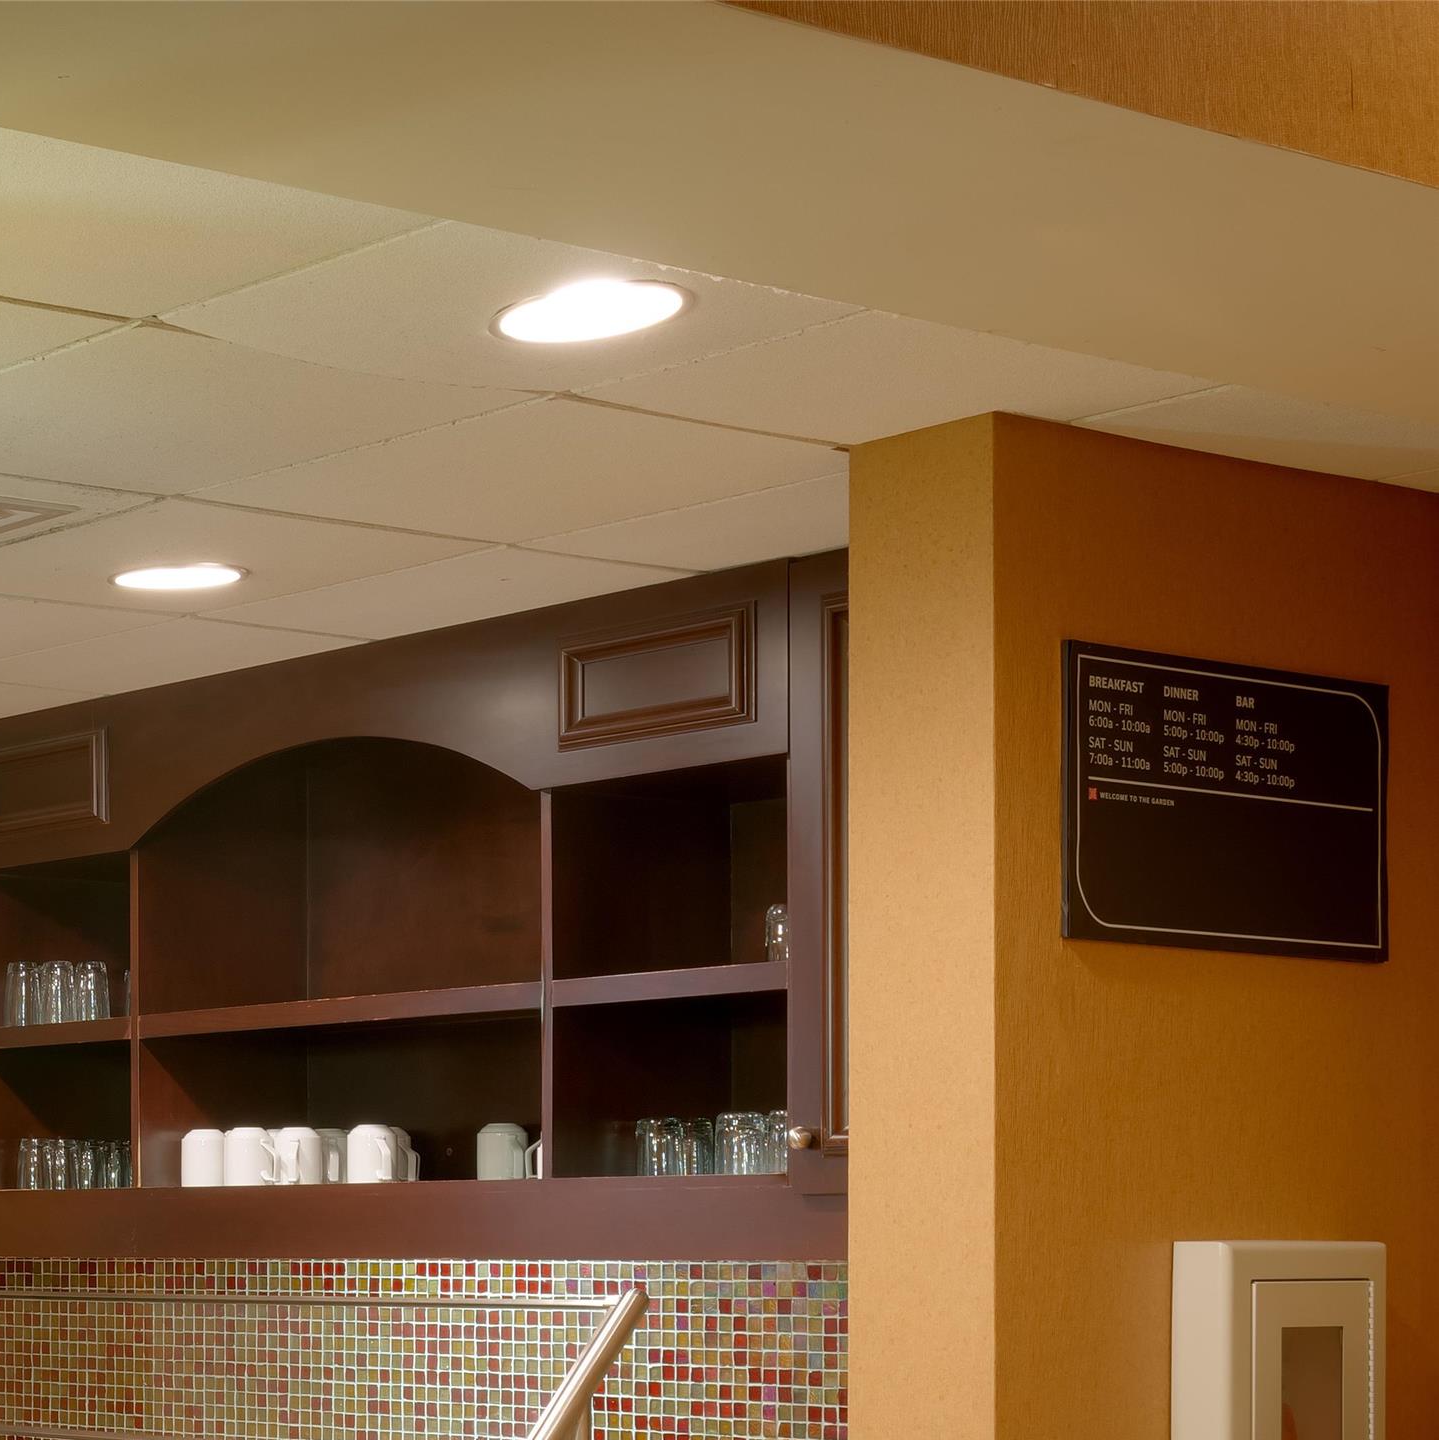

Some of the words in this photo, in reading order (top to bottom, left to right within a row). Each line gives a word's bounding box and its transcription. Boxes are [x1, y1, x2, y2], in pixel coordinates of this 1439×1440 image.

[1088, 675, 1144, 694] BREAKFAST
[1163, 685, 1199, 702] DINNER
[1235, 695, 1255, 709] BAR
[1088, 699, 1111, 713] MON
[1119, 703, 1133, 716] FRI
[1088, 715, 1113, 729] 6:00a
[1121, 719, 1151, 734] 10:00a
[1163, 709, 1185, 723] MON
[1192, 712, 1207, 726] FRI
[1163, 724, 1188, 740] 5:00p
[1195, 729, 1225, 745] 10:00p
[1235, 719, 1257, 732] MON
[1264, 722, 1278, 735] FRI
[1088, 736, 1106, 749] SAT
[1113, 739, 1133, 753] SUN
[1235, 734, 1259, 749] 4:30p
[1267, 738, 1295, 754] 10:00p
[1089, 752, 1113, 766] 7:00a
[1121, 757, 1151, 771] 11:00a
[1163, 745, 1181, 759] SAT
[1187, 748, 1207, 762] SUN
[1235, 754, 1252, 767] SAT
[1259, 757, 1277, 770] SUN
[1163, 761, 1188, 776] 5:00p
[1195, 765, 1225, 781] 10:00p
[1235, 770, 1259, 785] 4:30p
[1267, 774, 1295, 789] 10:00p
[1099, 792, 1128, 802] WELCOME
[1129, 795, 1138, 803] TO
[1139, 796, 1150, 804] THE
[1151, 797, 1175, 807] GARDEN
